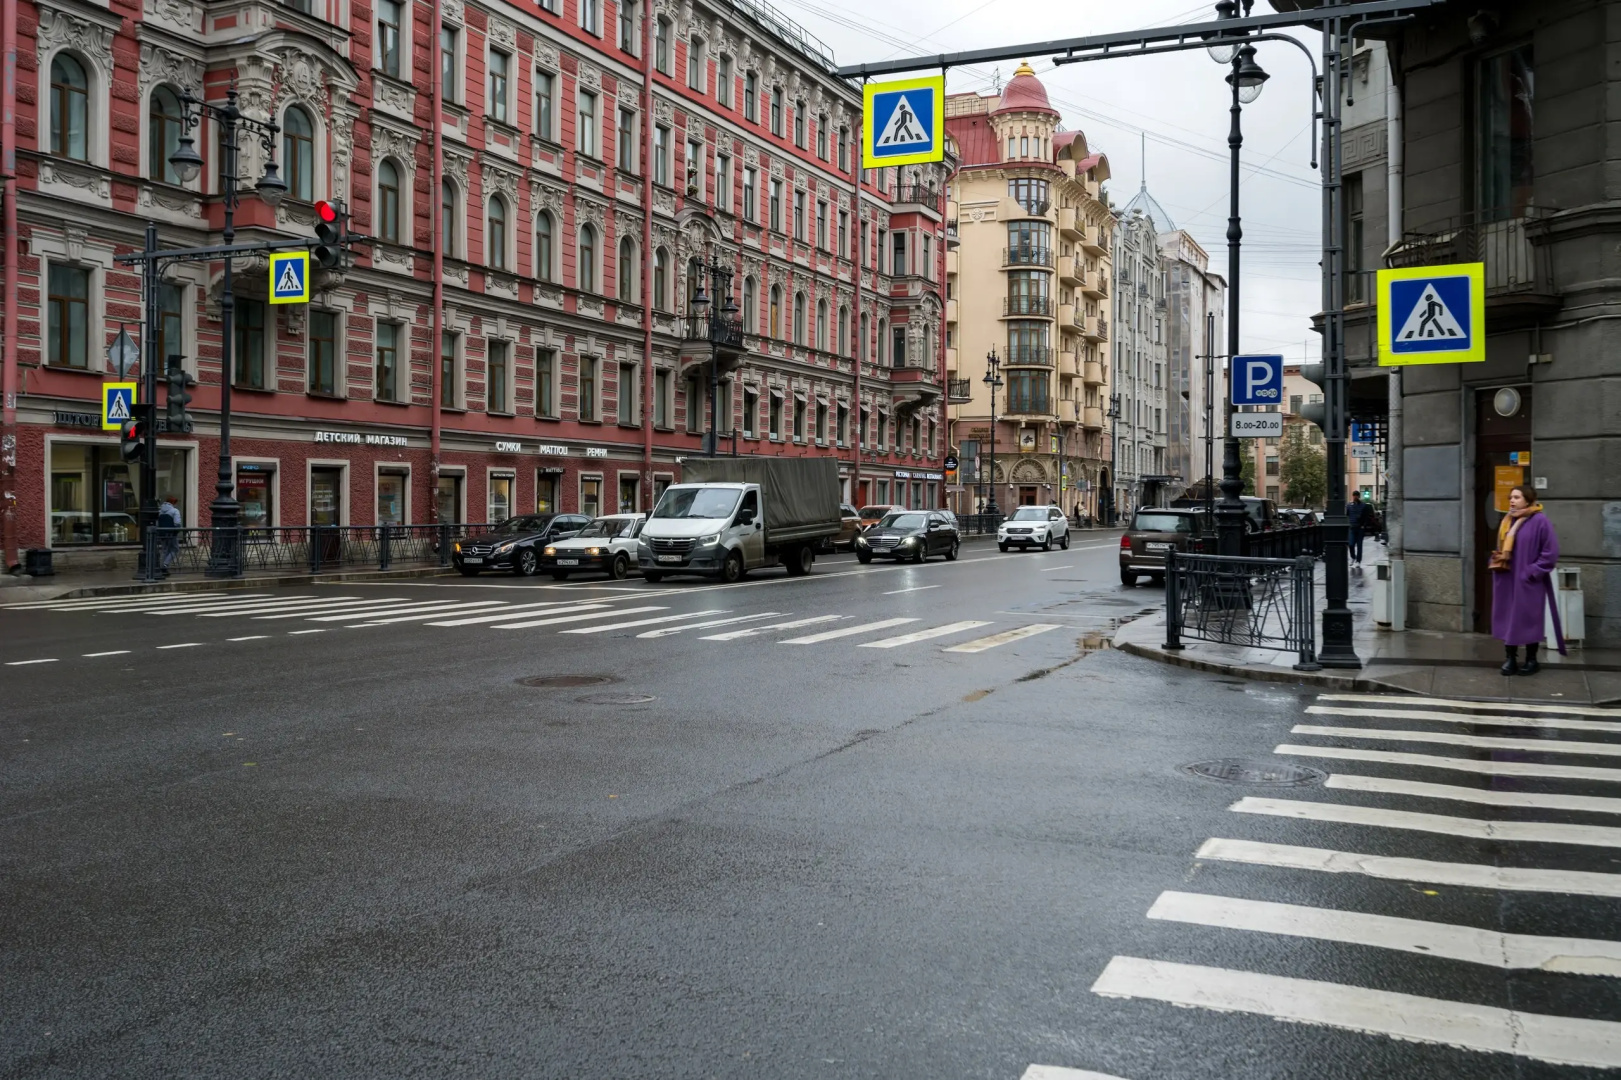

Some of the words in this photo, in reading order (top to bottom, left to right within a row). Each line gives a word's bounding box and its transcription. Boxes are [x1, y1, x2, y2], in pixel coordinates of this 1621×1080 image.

[1246, 361, 1273, 399] P
[1235, 420, 1279, 429] 8.00-20.00
[315, 431, 360, 443] ДЕТСКИЙ
[365, 434, 408, 446] МАГАЗИН
[496, 441, 521, 452] СУМКИ
[540, 445, 568, 455] MATTIOLI
[587, 447, 607, 457] РЕМНИ
